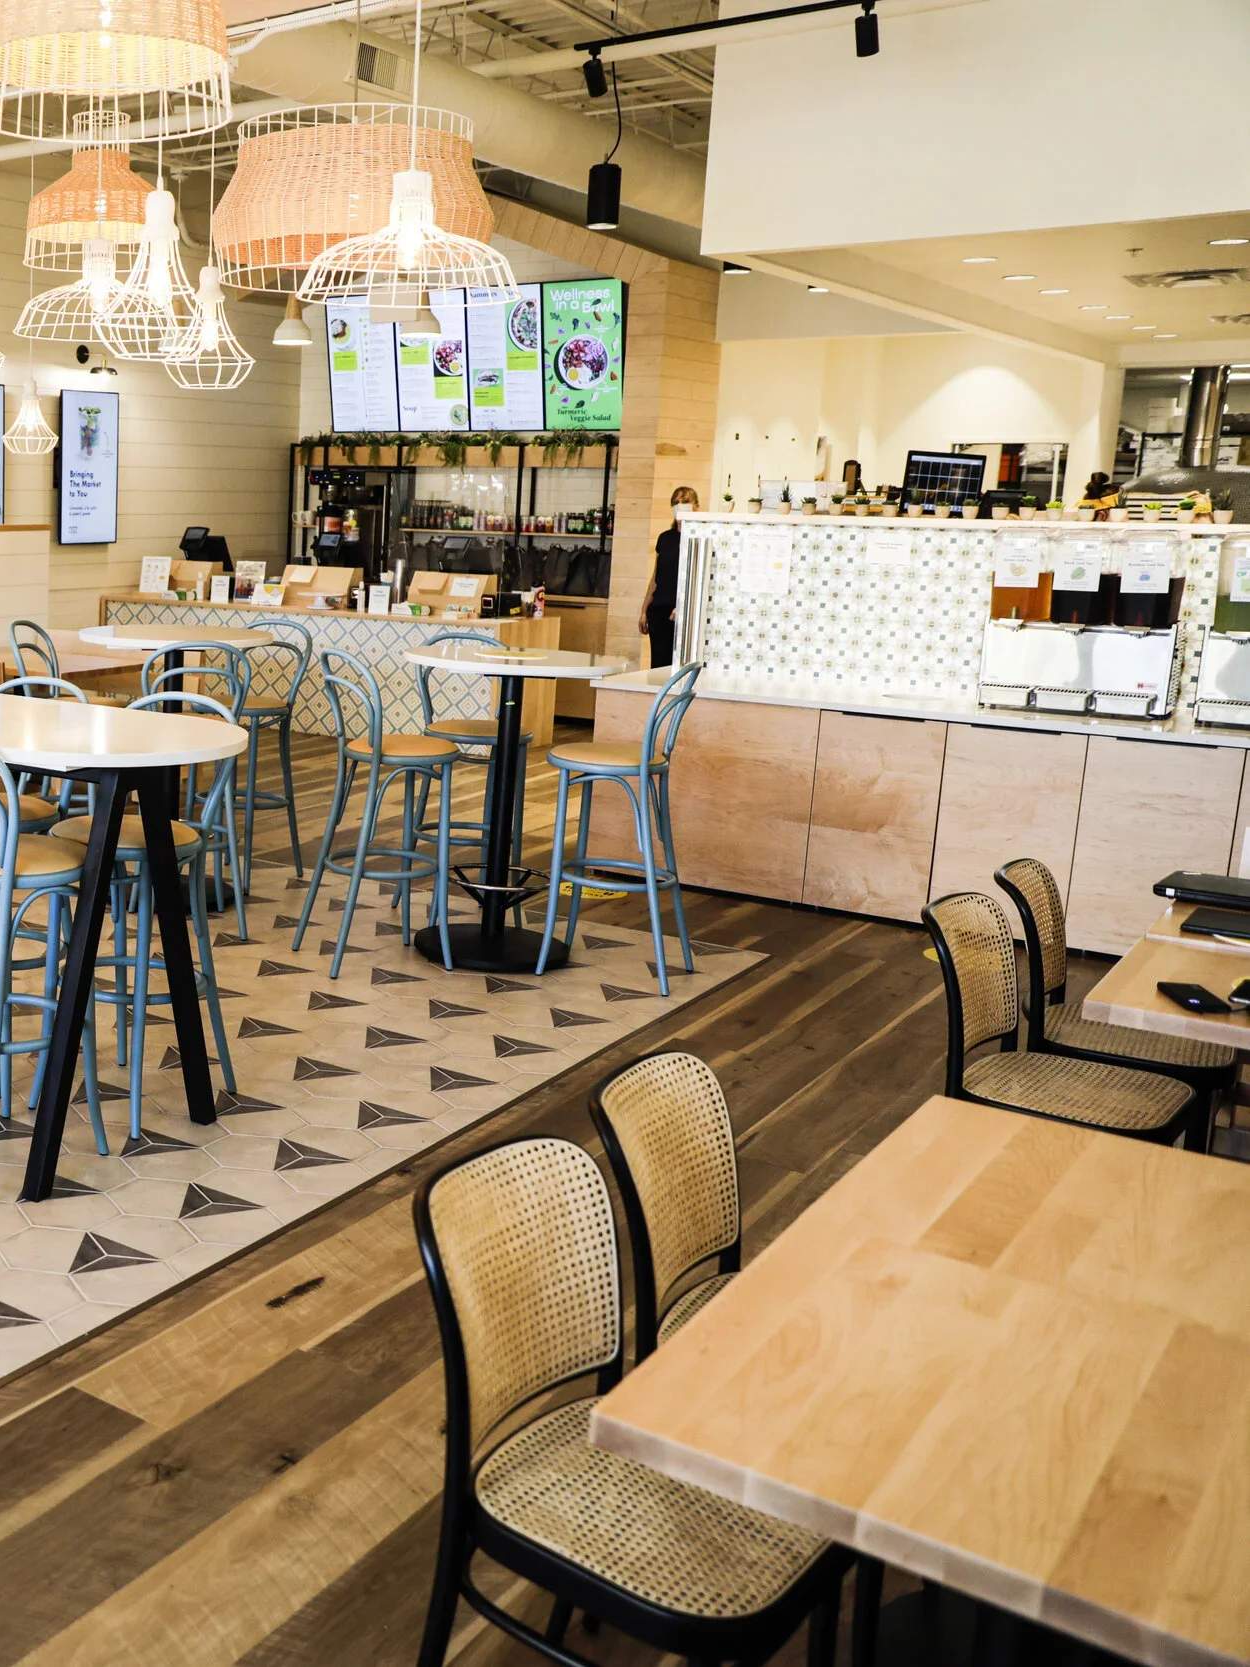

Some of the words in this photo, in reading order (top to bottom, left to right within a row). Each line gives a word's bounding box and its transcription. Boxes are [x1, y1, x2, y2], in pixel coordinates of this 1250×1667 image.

[549, 288, 611, 302] Wellness
[555, 300, 567, 311] in
[570, 301, 580, 310] a
[582, 299, 615, 313] Bowl
[557, 407, 587, 416] Turmeric
[570, 414, 591, 423] Veggie
[592, 414, 612, 422] Salad
[69, 470, 94, 479] Bringing
[69, 480, 80, 488] The
[81, 480, 102, 488] Market
[76, 490, 88, 498] You
